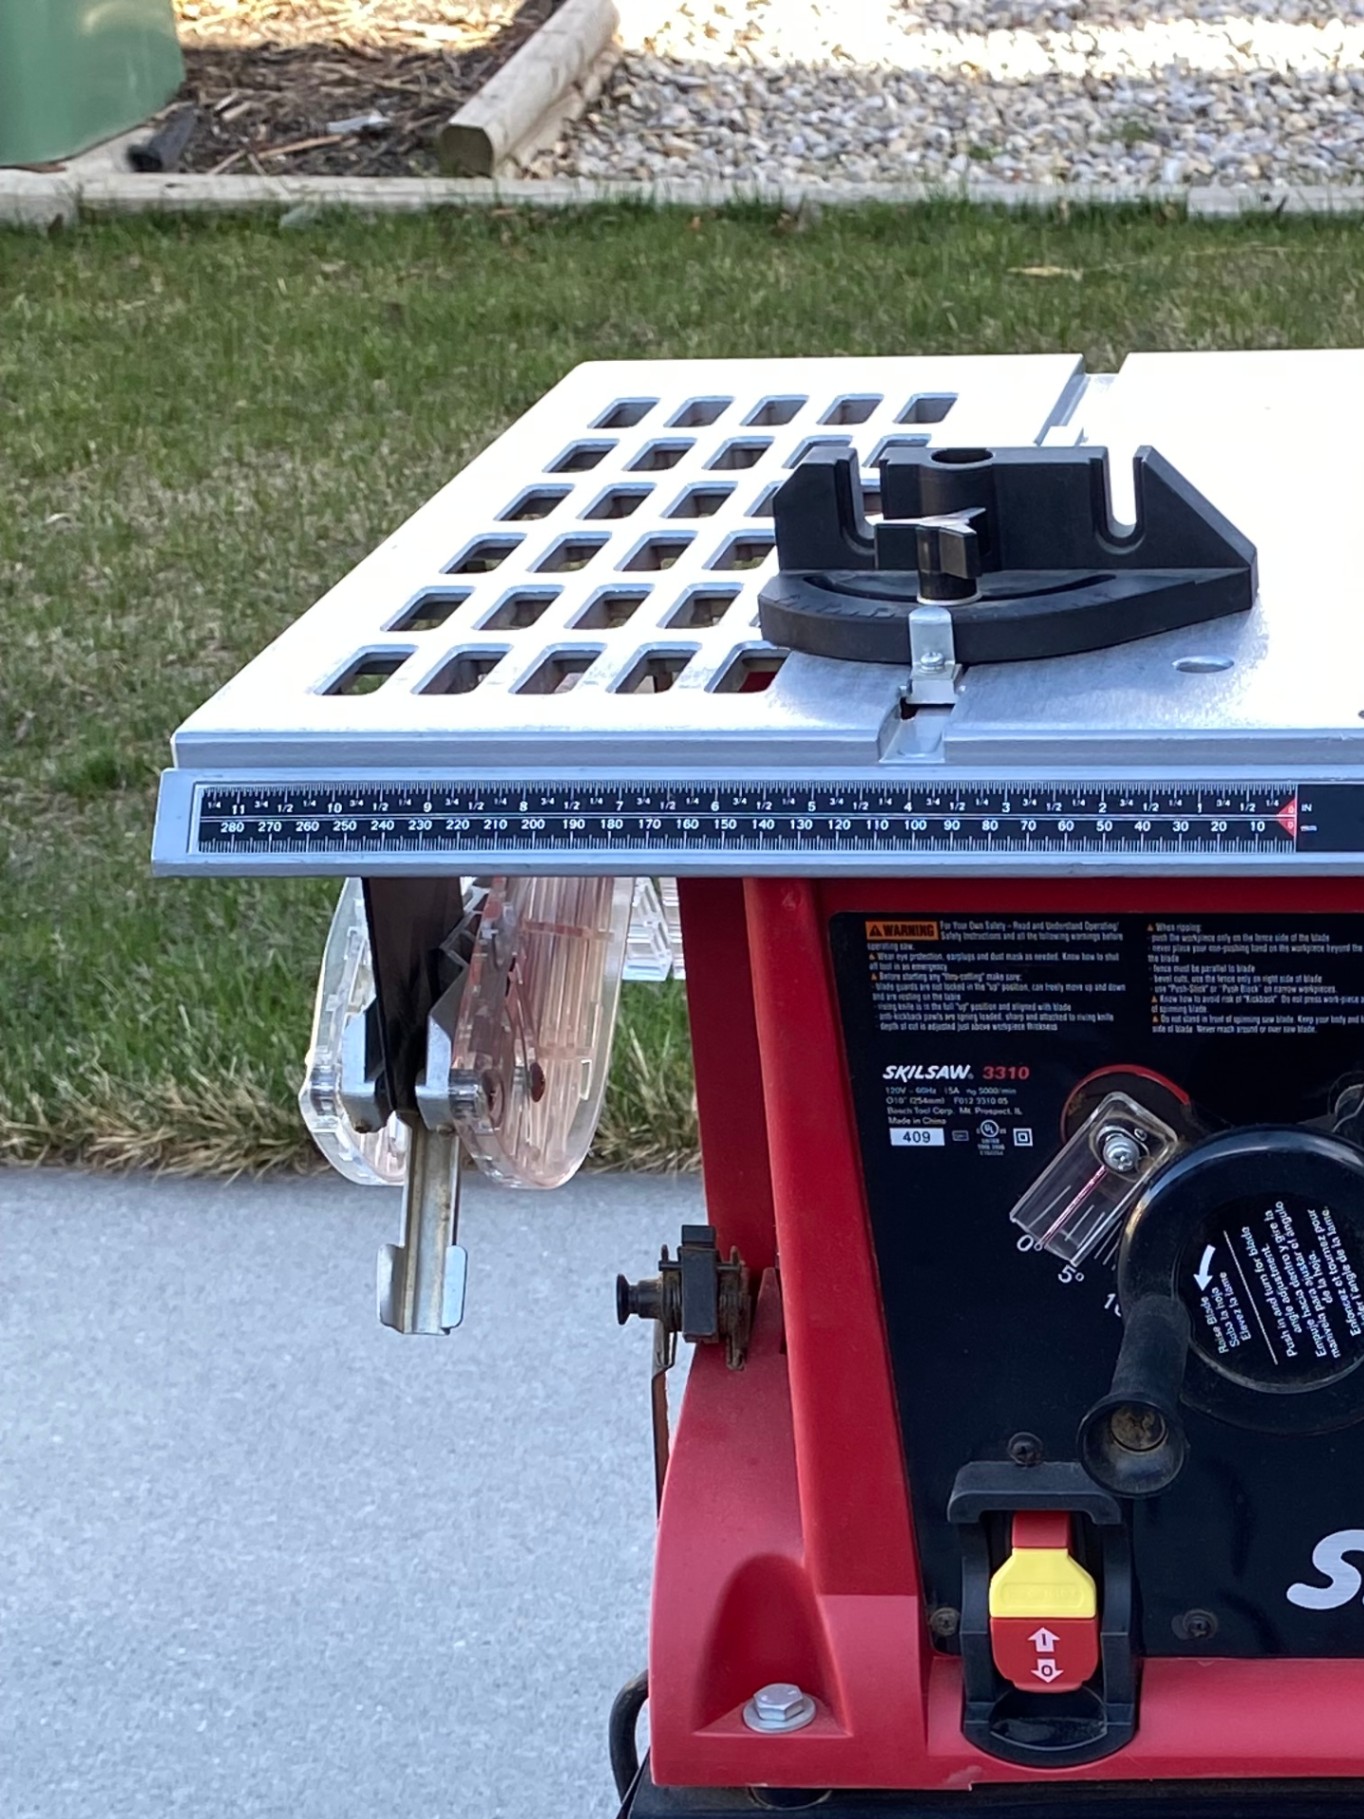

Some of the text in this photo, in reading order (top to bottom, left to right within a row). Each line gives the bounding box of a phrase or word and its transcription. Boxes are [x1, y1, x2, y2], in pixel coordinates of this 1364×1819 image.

[231, 802, 342, 814] 11 10
[220, 818, 1266, 832] 280 270 260 250 240 230 220 210 200 190 180 170 160 150 140 130 120 110 100 90 80 70 60 50 40 30 20 10
[882, 924, 935, 937] WARNING
[982, 1066, 1030, 1080] 3310
[902, 1131, 931, 1143] 409
